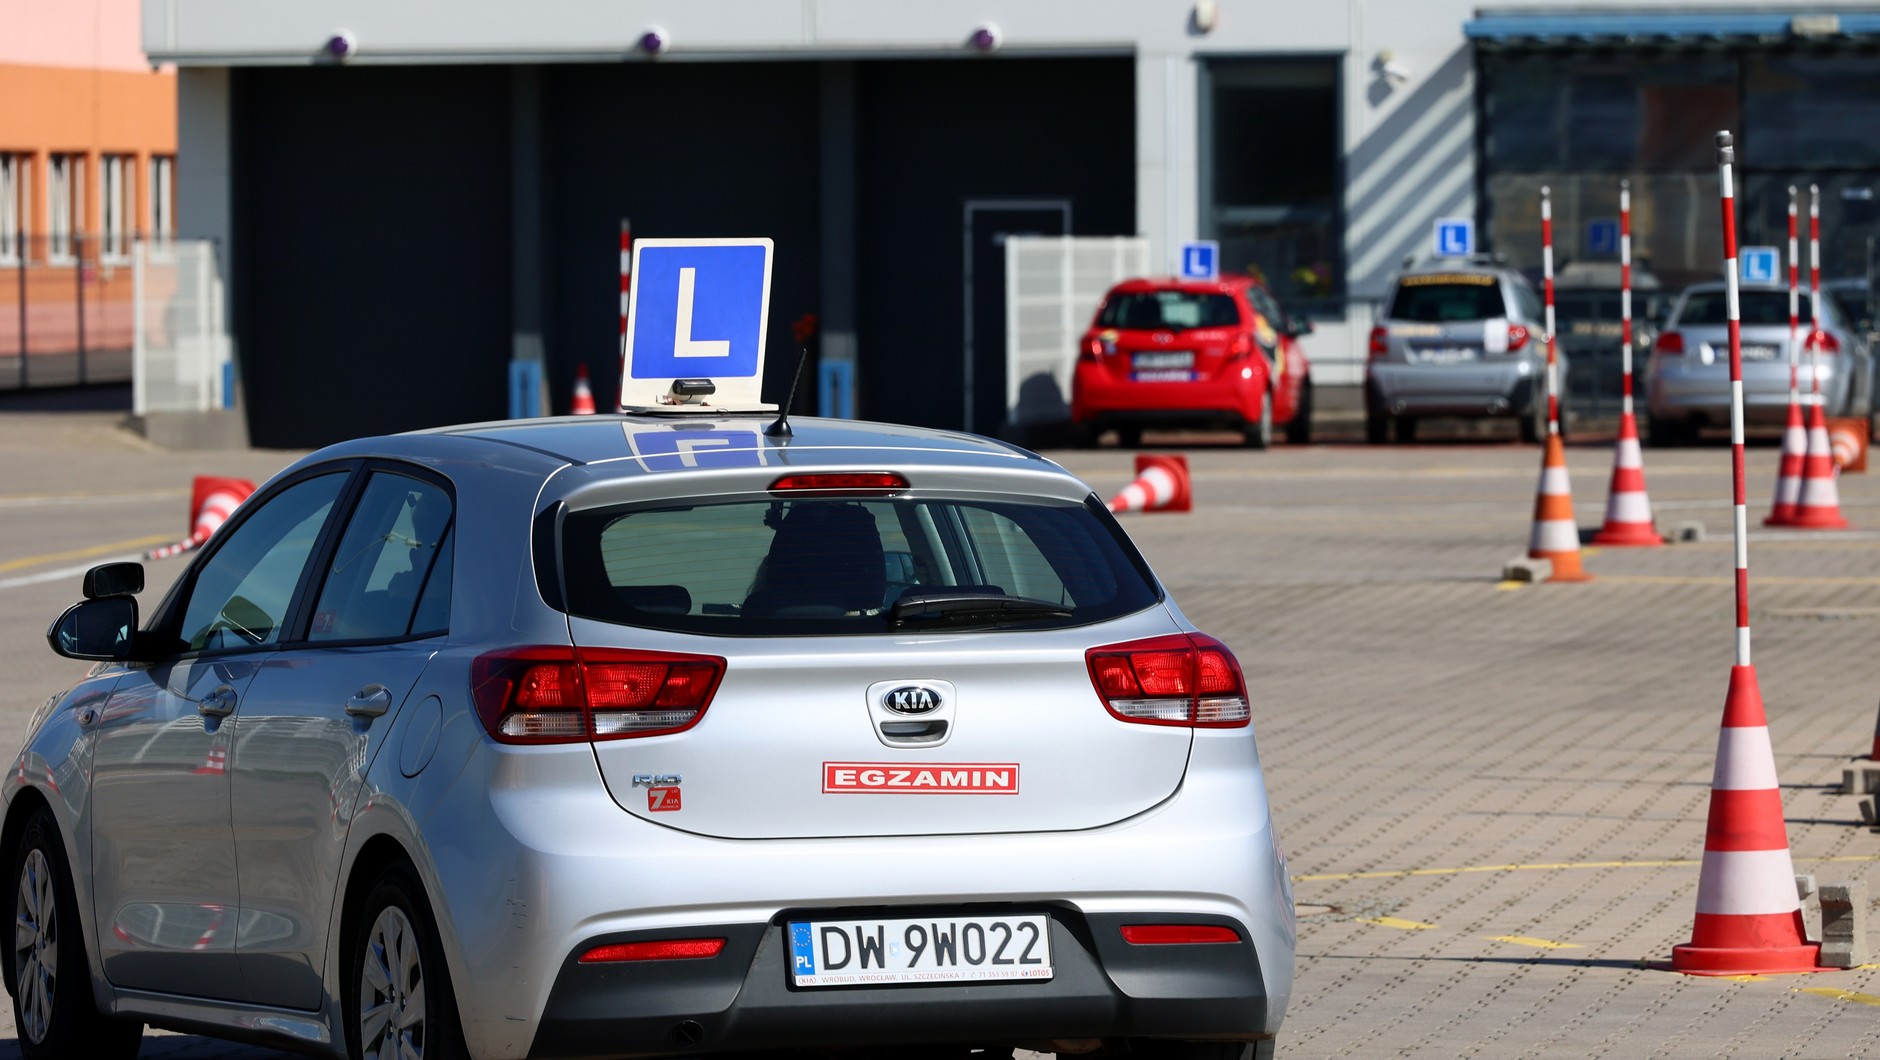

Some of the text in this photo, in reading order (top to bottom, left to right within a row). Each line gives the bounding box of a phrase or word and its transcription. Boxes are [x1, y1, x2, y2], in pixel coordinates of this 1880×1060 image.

[1446, 228, 1465, 252] L
[1189, 250, 1209, 276] L
[1750, 254, 1768, 281] L
[673, 267, 730, 358] L
[893, 691, 934, 710] KIA
[632, 773, 683, 784] RIO
[834, 769, 1010, 788] EGZAMIN
[649, 789, 668, 810] 7
[820, 921, 1043, 971] DW 9W022
[796, 956, 812, 969] PL
[1029, 969, 1050, 977] LOTOS
